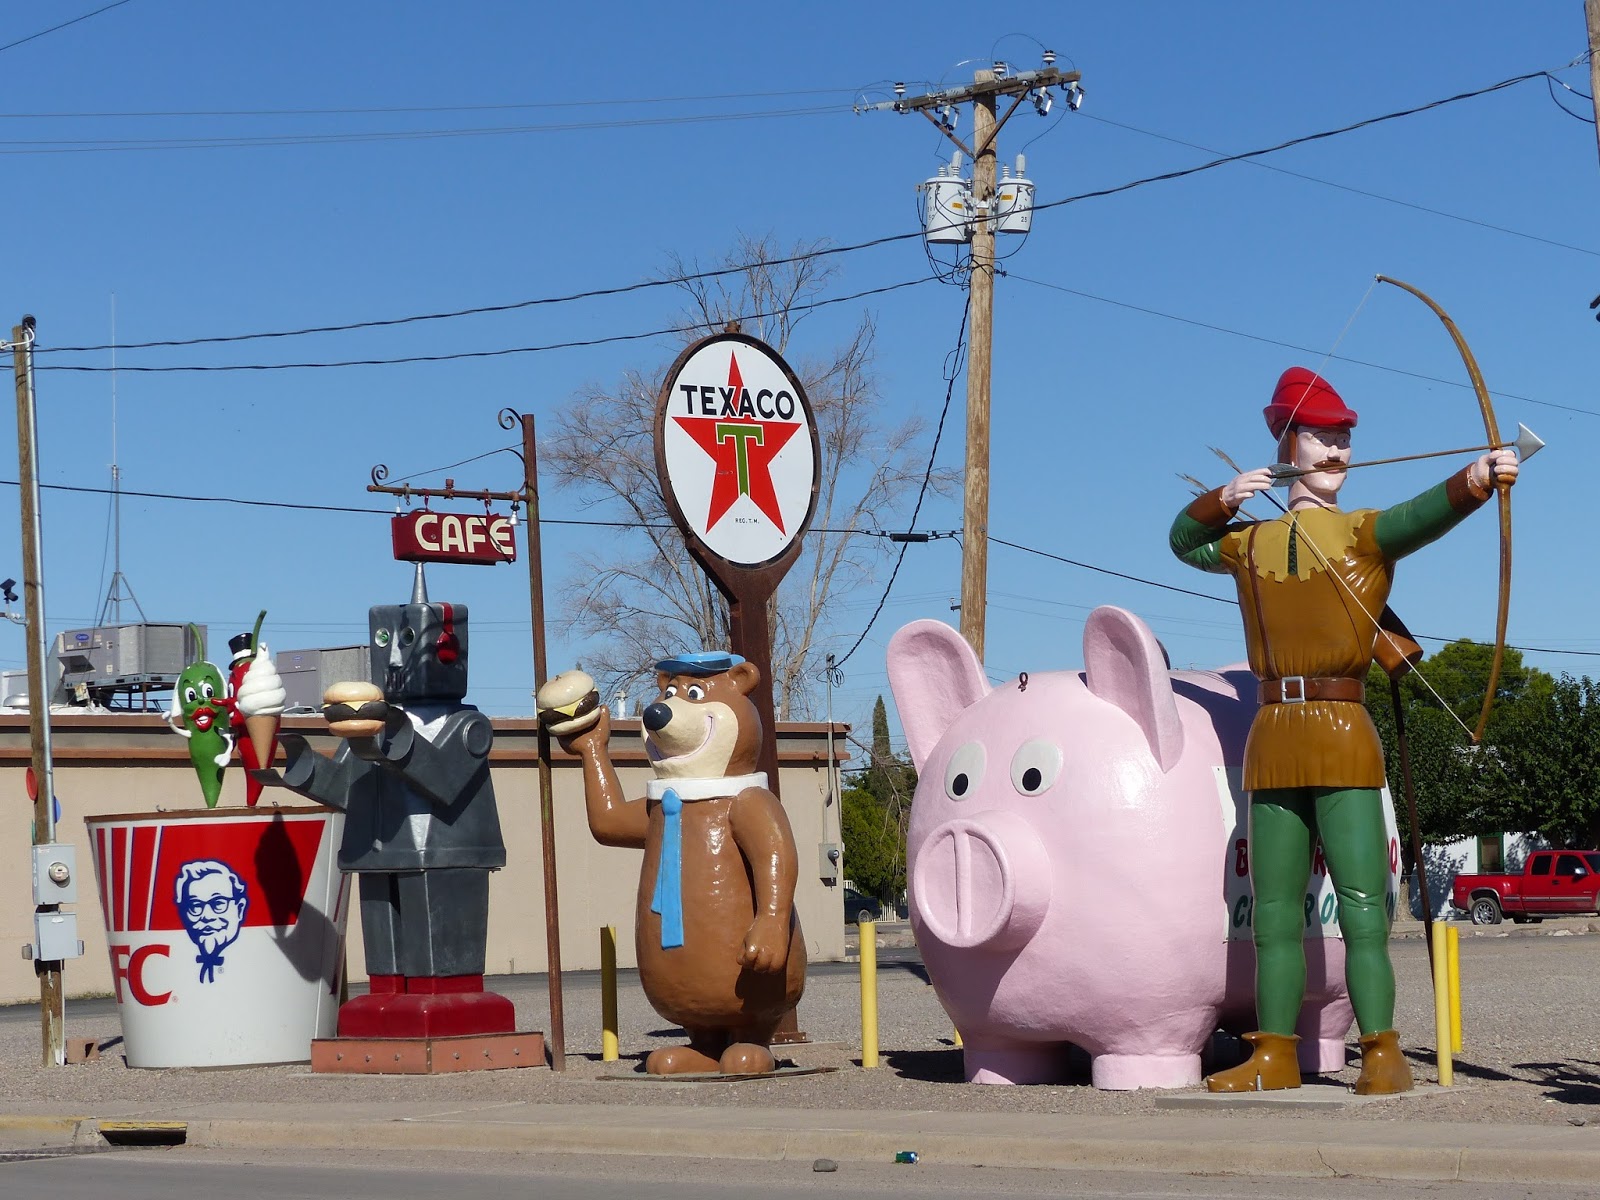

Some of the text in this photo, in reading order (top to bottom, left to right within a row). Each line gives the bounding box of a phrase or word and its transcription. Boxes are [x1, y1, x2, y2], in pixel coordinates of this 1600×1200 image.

[680, 385, 795, 420] TEXACO
[716, 424, 764, 496] T
[415, 514, 514, 555] CAFE
[110, 944, 173, 1006] FC
